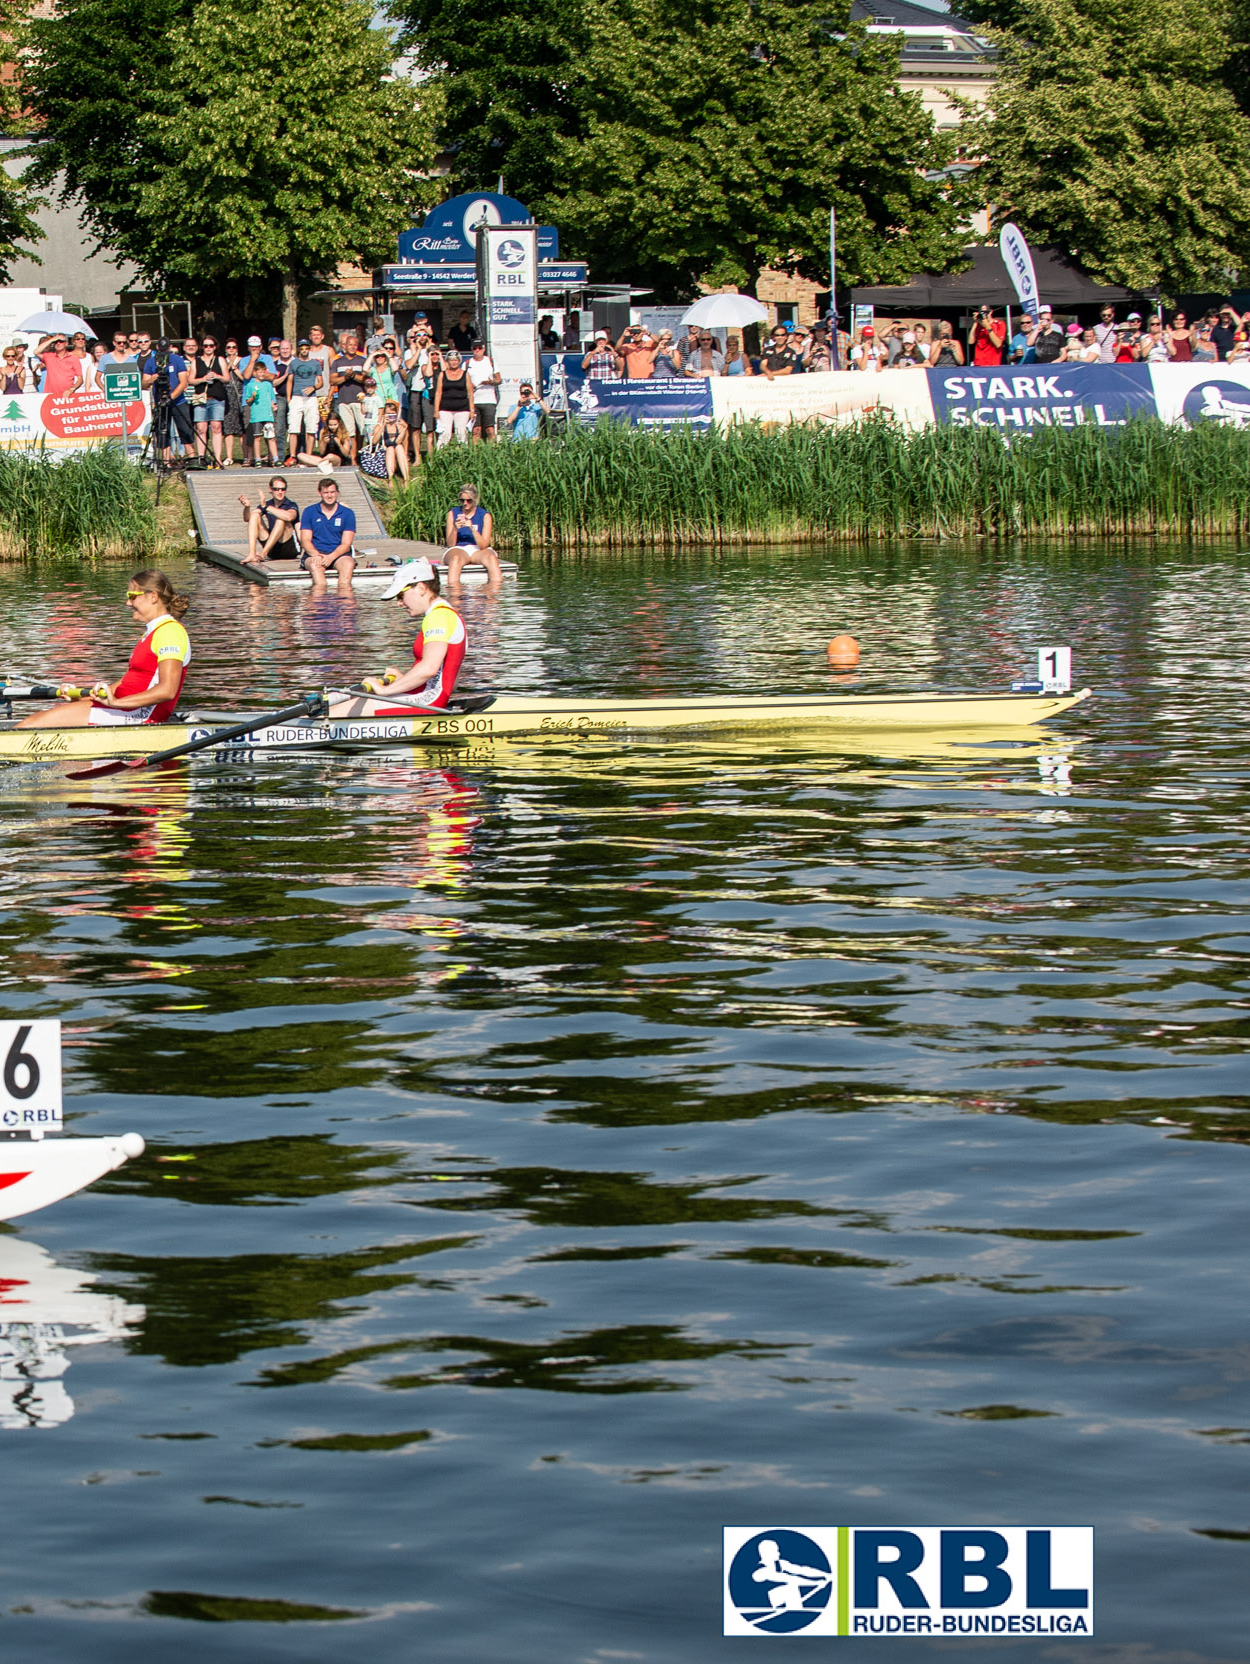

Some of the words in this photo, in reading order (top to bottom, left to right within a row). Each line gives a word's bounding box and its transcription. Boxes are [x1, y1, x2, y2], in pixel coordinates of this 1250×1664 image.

[497, 274, 525, 285] RBL
[943, 376, 1075, 401] STARK.
[52, 396, 75, 406] Wir
[61, 416, 80, 425] für
[949, 404, 1127, 427] SCHNELL.
[430, 628, 445, 636] RBL
[1045, 651, 1057, 678] 1
[421, 722, 432, 734] Z
[437, 721, 460, 734] BS
[465, 719, 494, 733] 001
[540, 717, 574, 729] Erich
[576, 716, 627, 729] Domeier
[266, 725, 408, 742] RUDER-BUNDESLIGA
[22, 731, 70, 752] Melitta
[3, 1025, 40, 1100] 6
[23, 1109, 63, 1122] RBL
